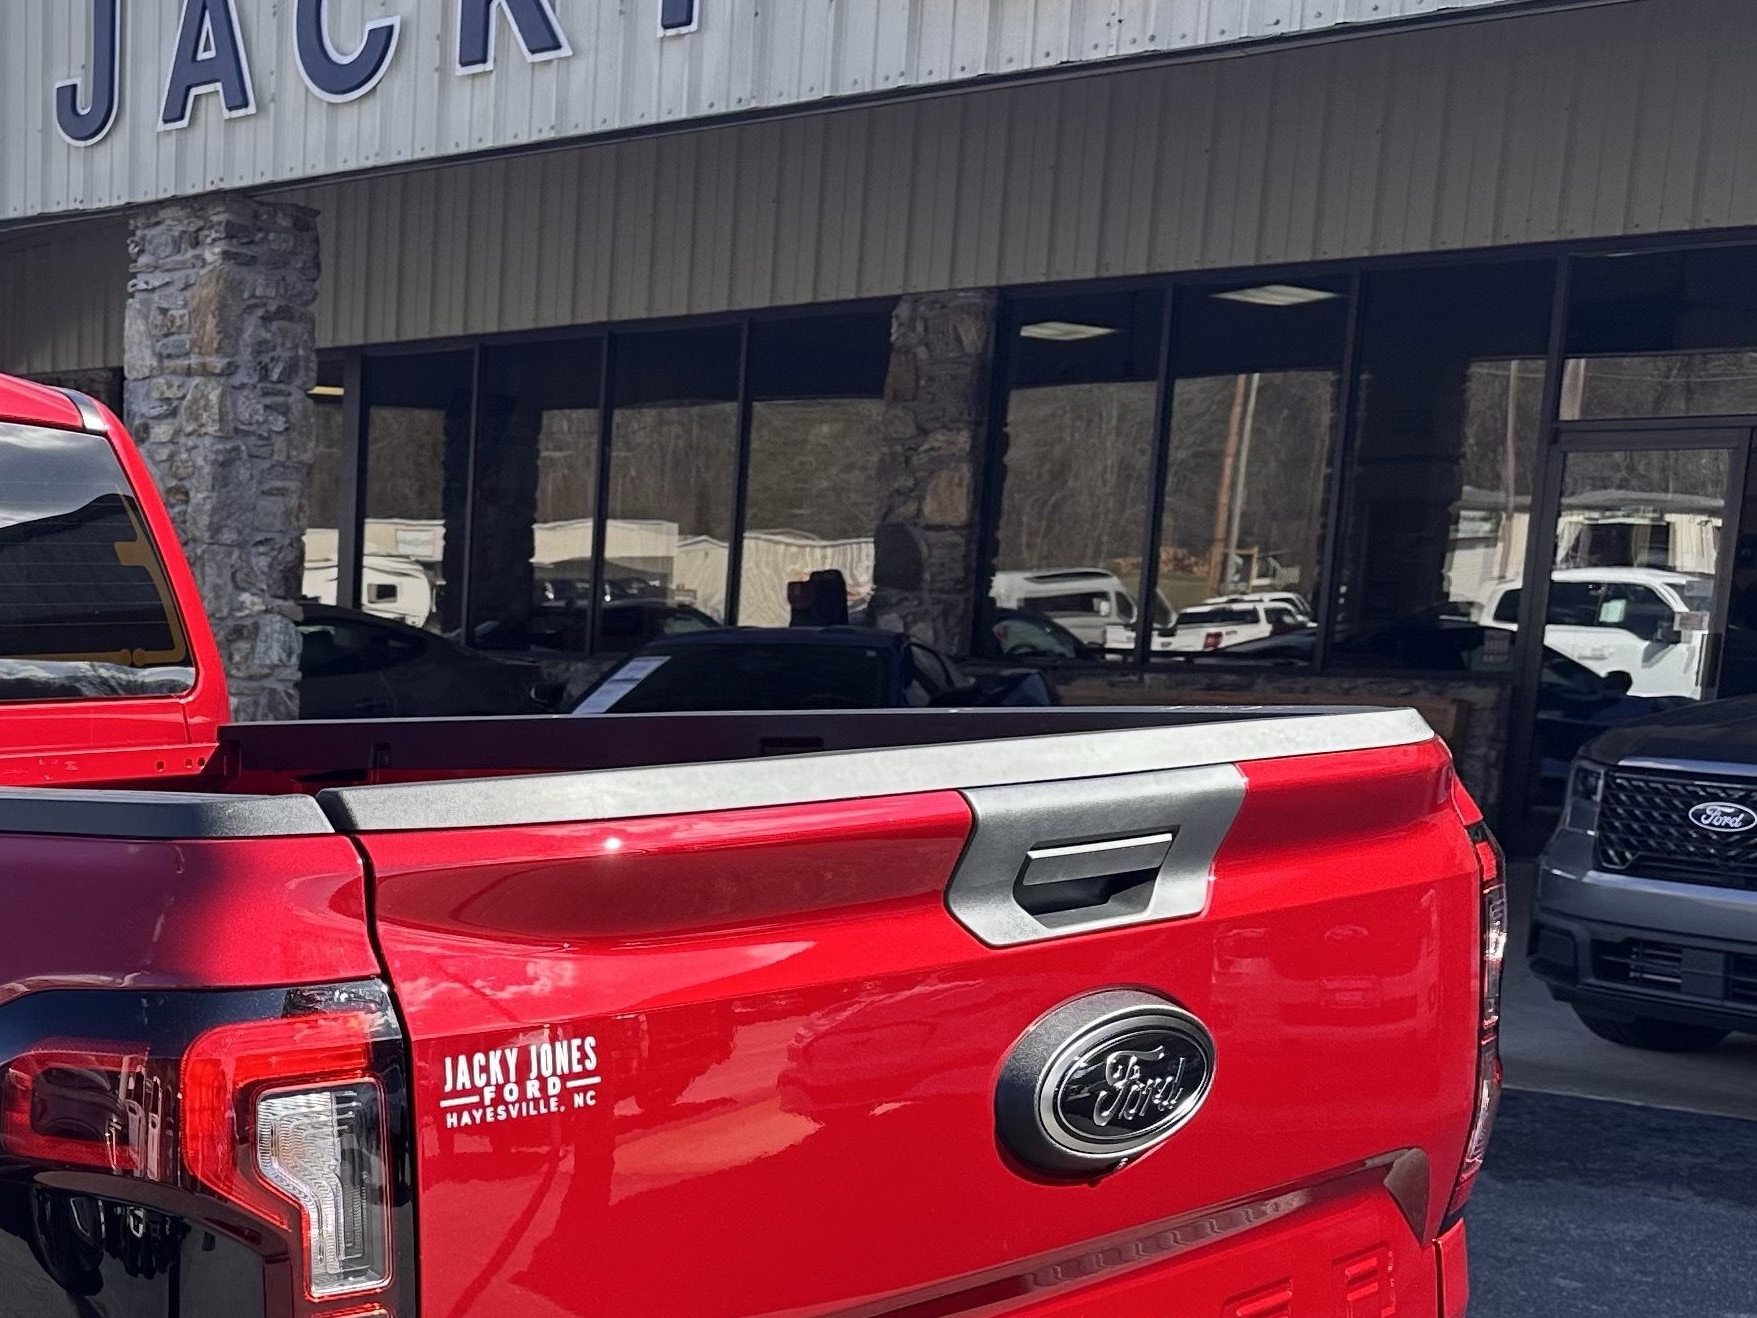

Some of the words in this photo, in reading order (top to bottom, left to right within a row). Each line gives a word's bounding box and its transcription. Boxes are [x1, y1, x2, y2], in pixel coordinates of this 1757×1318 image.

[1700, 805, 1745, 828] Ford
[444, 1047, 519, 1093] JACKY
[529, 1036, 597, 1080] JONES
[483, 1075, 562, 1106] FORD
[573, 1090, 597, 1108] NC
